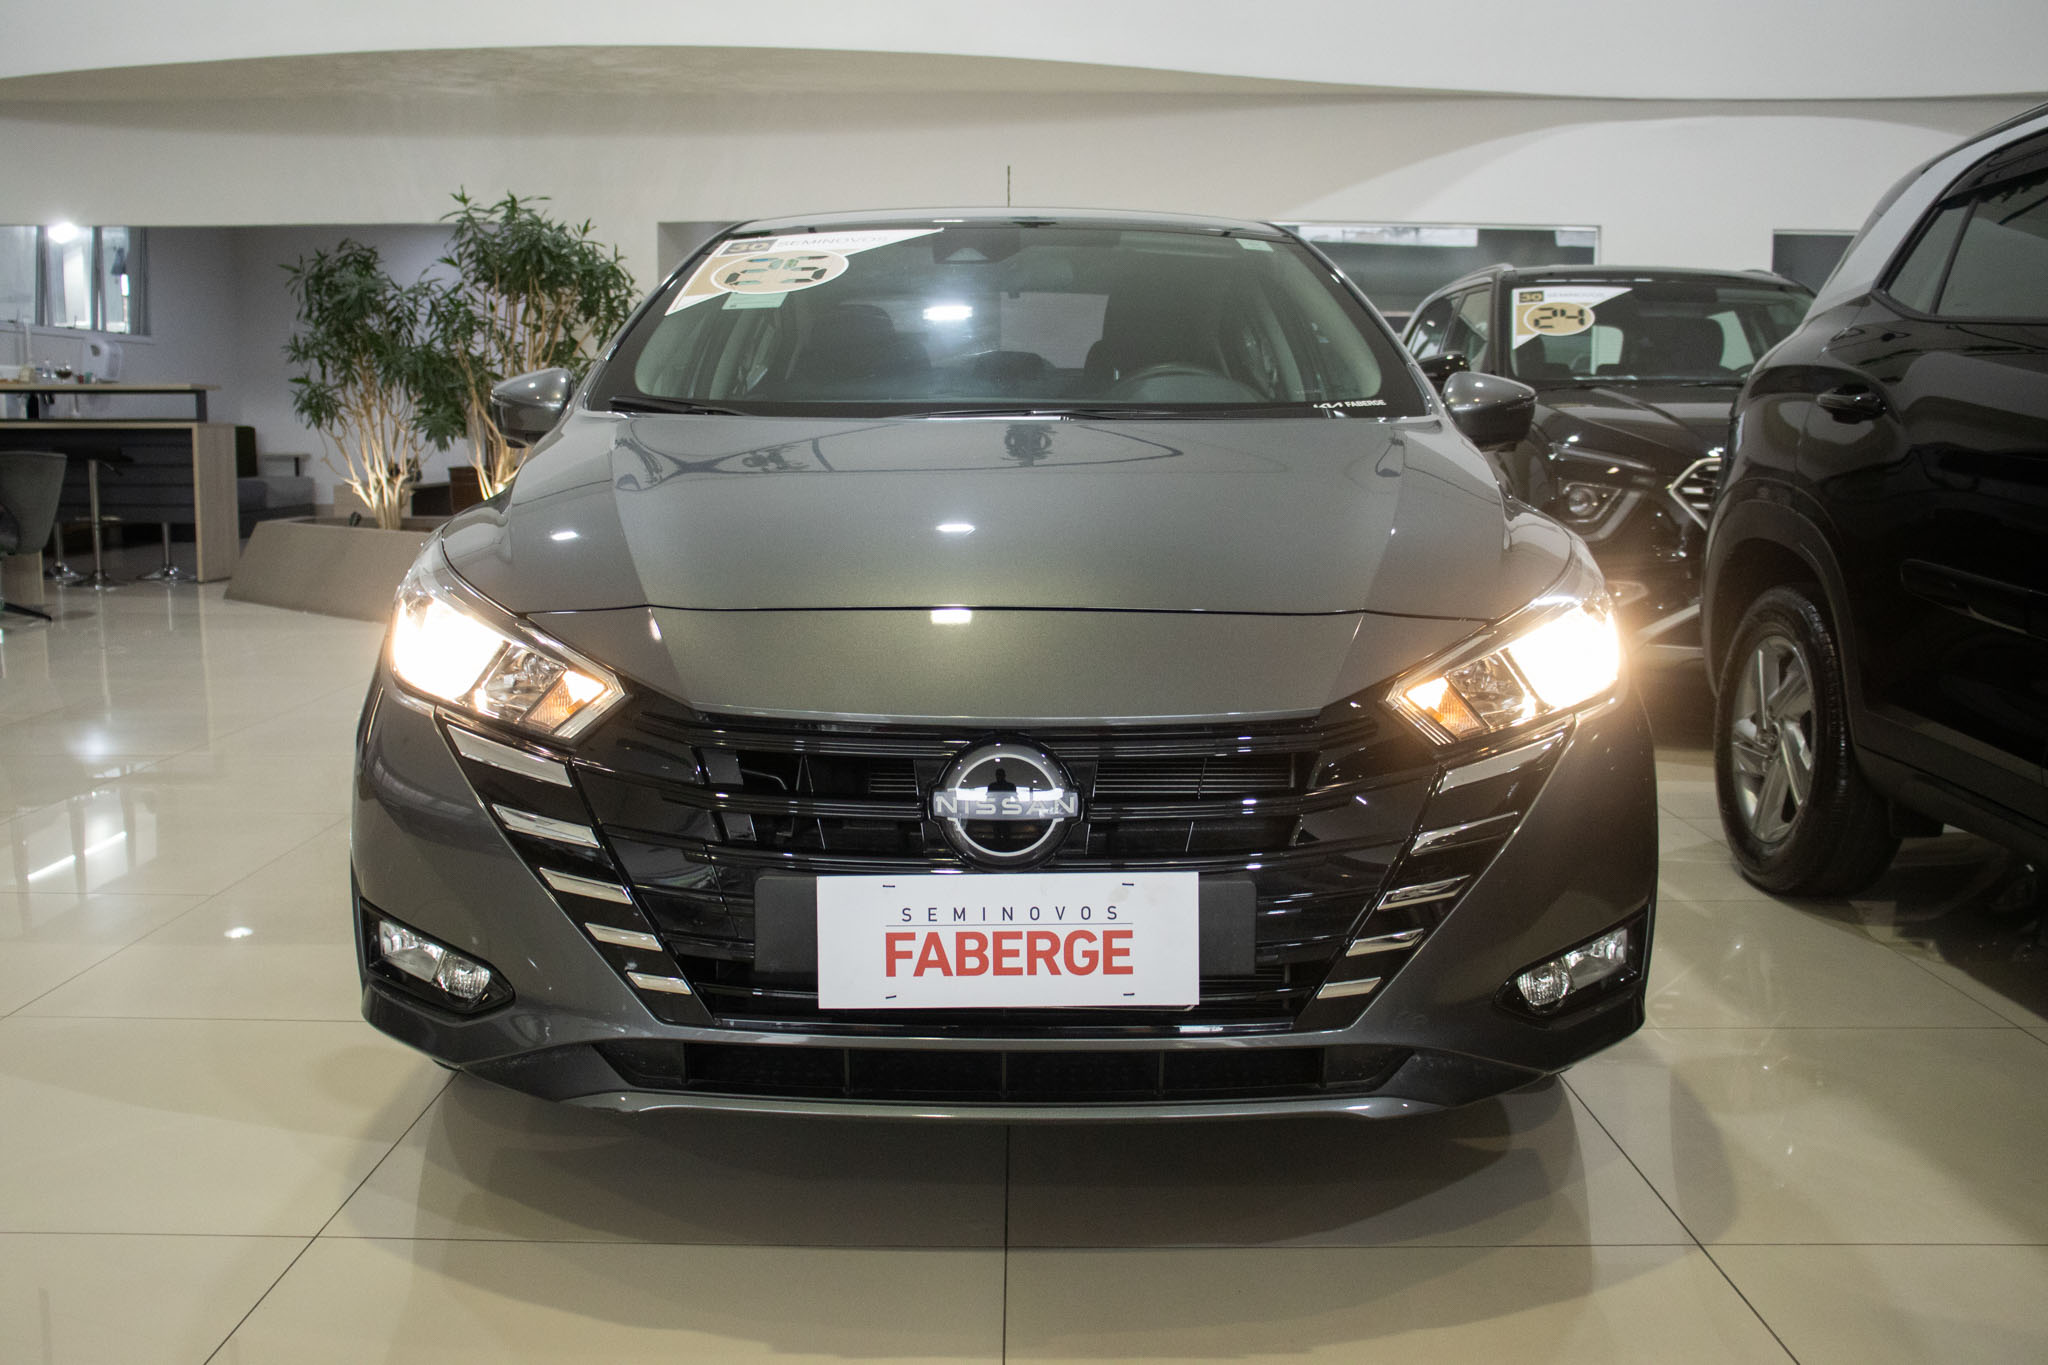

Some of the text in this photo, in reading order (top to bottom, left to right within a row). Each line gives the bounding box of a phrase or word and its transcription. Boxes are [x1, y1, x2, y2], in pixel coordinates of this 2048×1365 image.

[728, 235, 888, 254] 30 SEMINOVOS
[1534, 307, 1585, 329] 24
[936, 795, 1075, 815] NISSAN
[901, 905, 1118, 922] SEMINOVOS
[885, 930, 1133, 977] FABERGE
